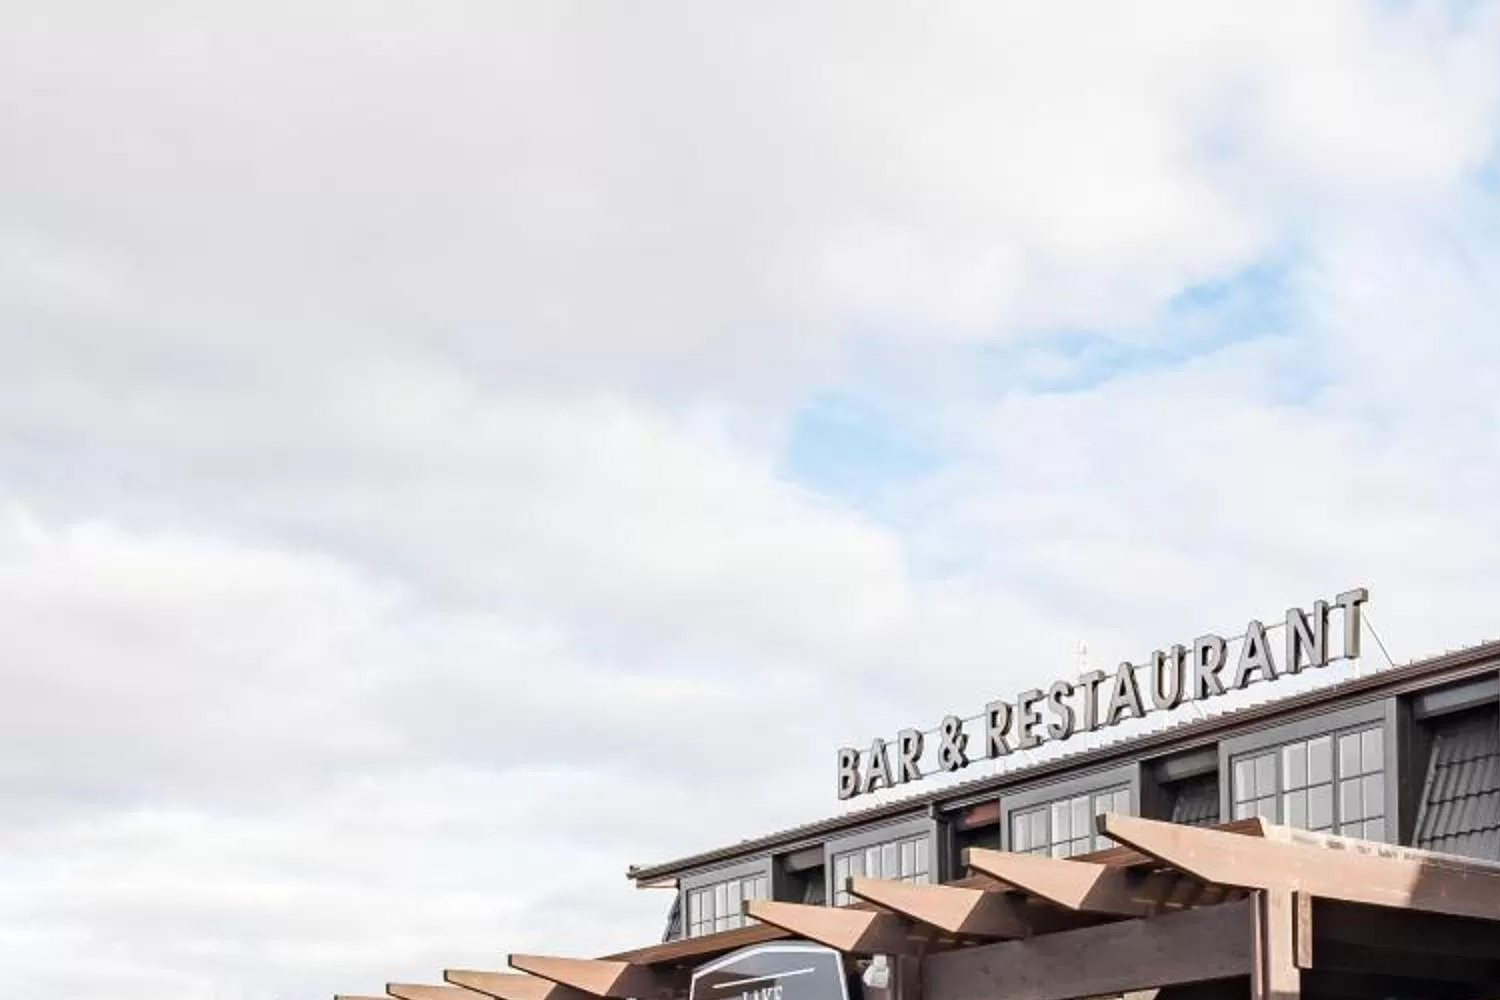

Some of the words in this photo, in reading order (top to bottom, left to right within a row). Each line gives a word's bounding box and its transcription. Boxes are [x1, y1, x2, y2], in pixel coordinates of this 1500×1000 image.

[838, 727, 923, 800] BAR
[938, 715, 969, 771] &
[985, 588, 1368, 759] RESTAURANT
